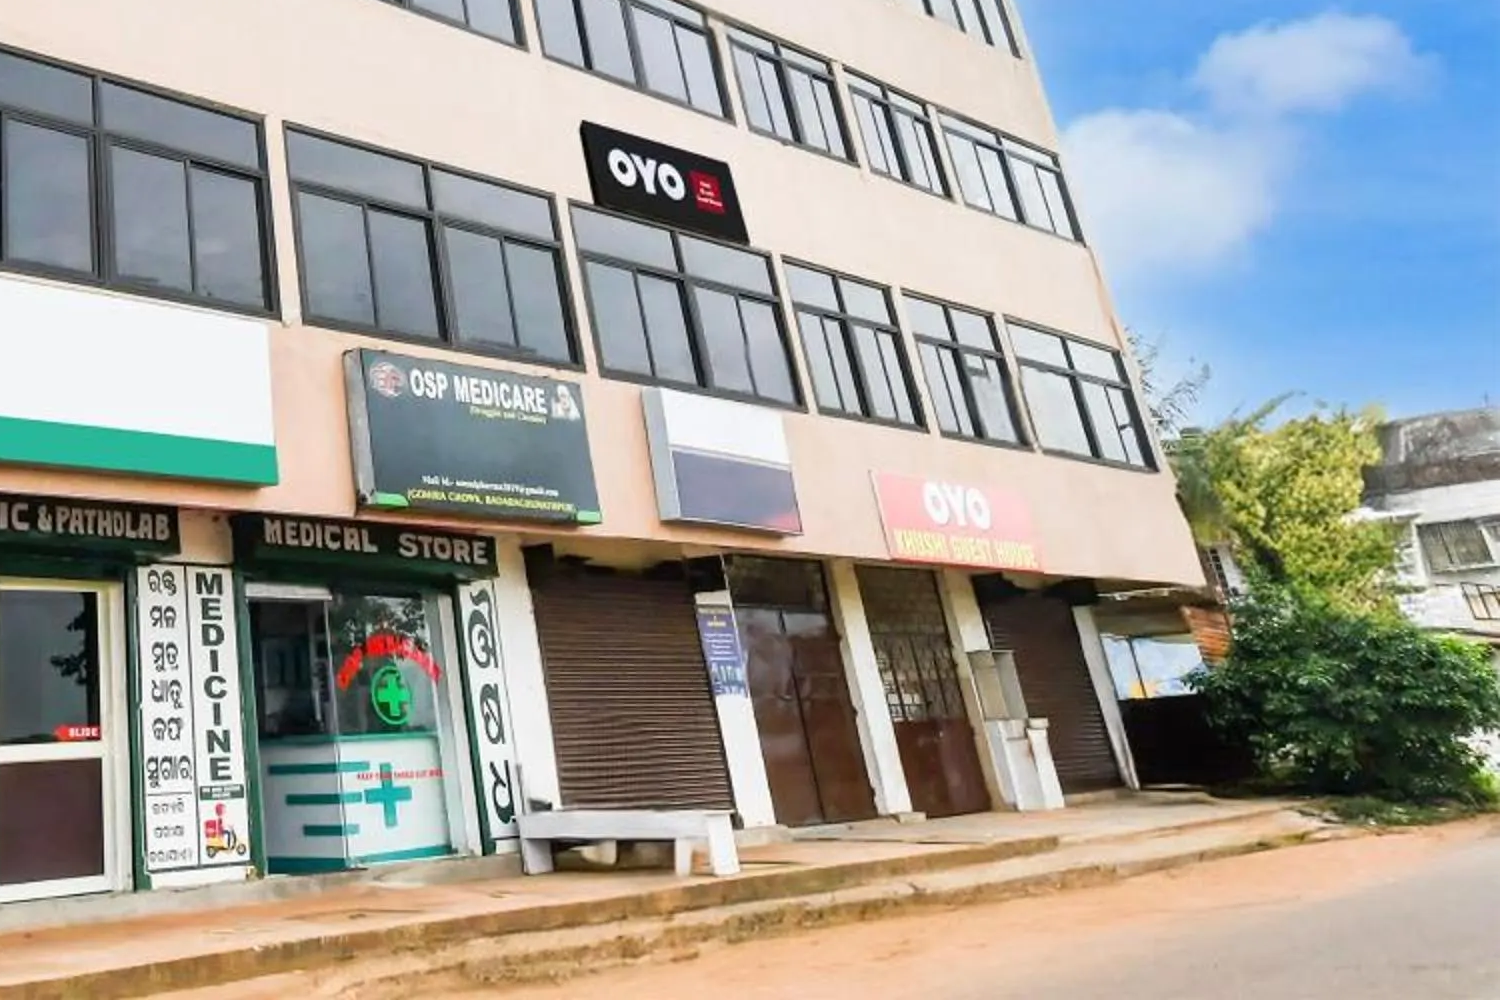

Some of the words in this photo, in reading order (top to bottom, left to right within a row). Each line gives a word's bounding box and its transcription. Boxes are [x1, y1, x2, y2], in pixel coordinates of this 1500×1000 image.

[607, 148, 686, 201] OYO
[409, 368, 449, 400] OSP
[453, 375, 548, 414] MEDICARE
[55, 505, 171, 541] PATHOLAB
[923, 481, 991, 531] OYO
[263, 518, 379, 554] MEDICAL
[398, 533, 489, 565] STORE
[195, 572, 233, 781] MEDICINE
